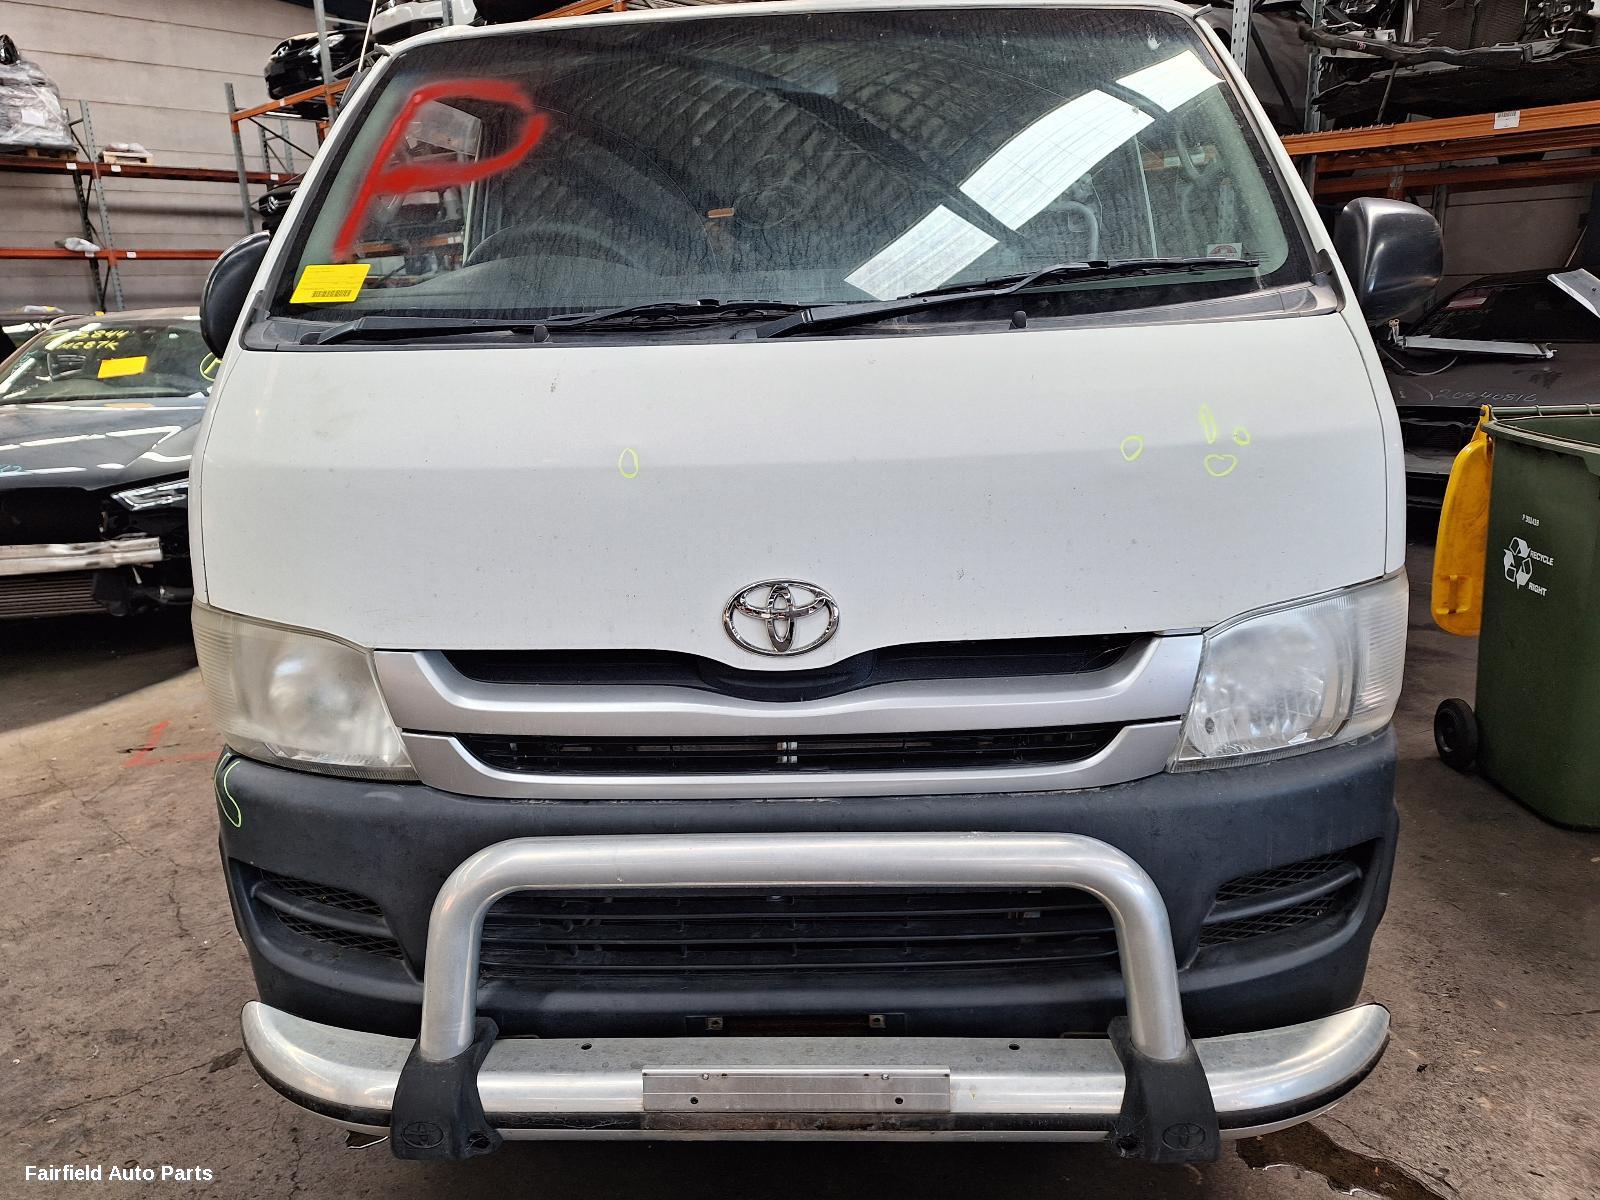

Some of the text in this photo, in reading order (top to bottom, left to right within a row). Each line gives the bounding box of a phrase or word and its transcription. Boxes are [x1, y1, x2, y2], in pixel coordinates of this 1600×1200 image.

[331, 79, 549, 261] P
[1530, 550, 1554, 566] RECYCLE
[1528, 582, 1548, 596] RIGHT
